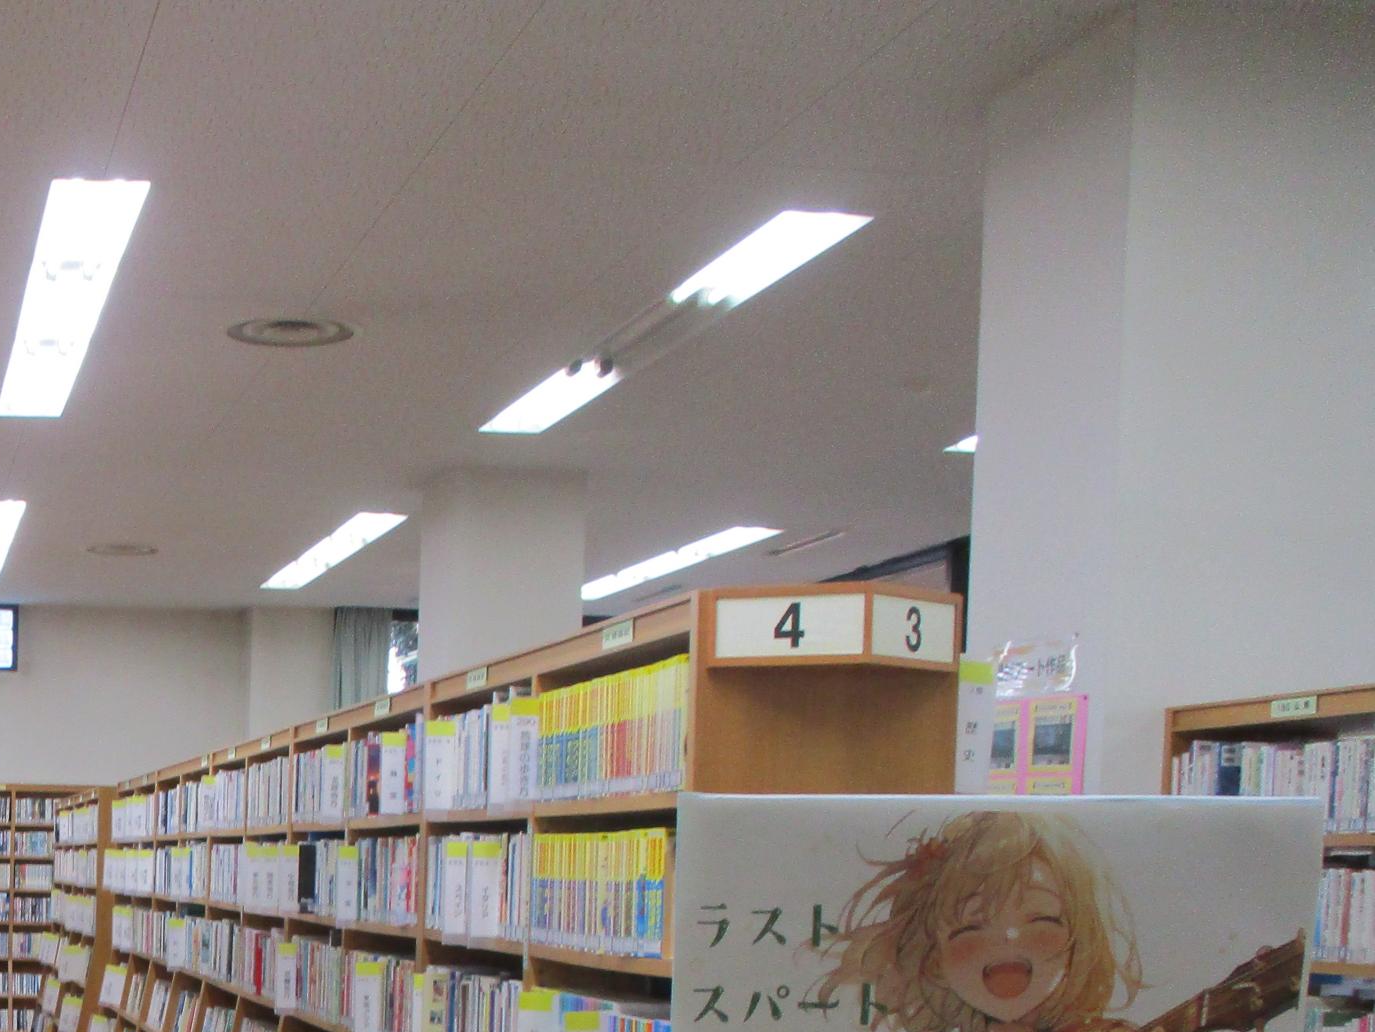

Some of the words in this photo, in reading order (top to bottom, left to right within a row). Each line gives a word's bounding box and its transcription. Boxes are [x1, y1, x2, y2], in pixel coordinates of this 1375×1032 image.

[774, 602, 804, 649] 4
[905, 607, 922, 652] 3
[697, 903, 841, 948] ラスト
[692, 984, 891, 1025] スパート
